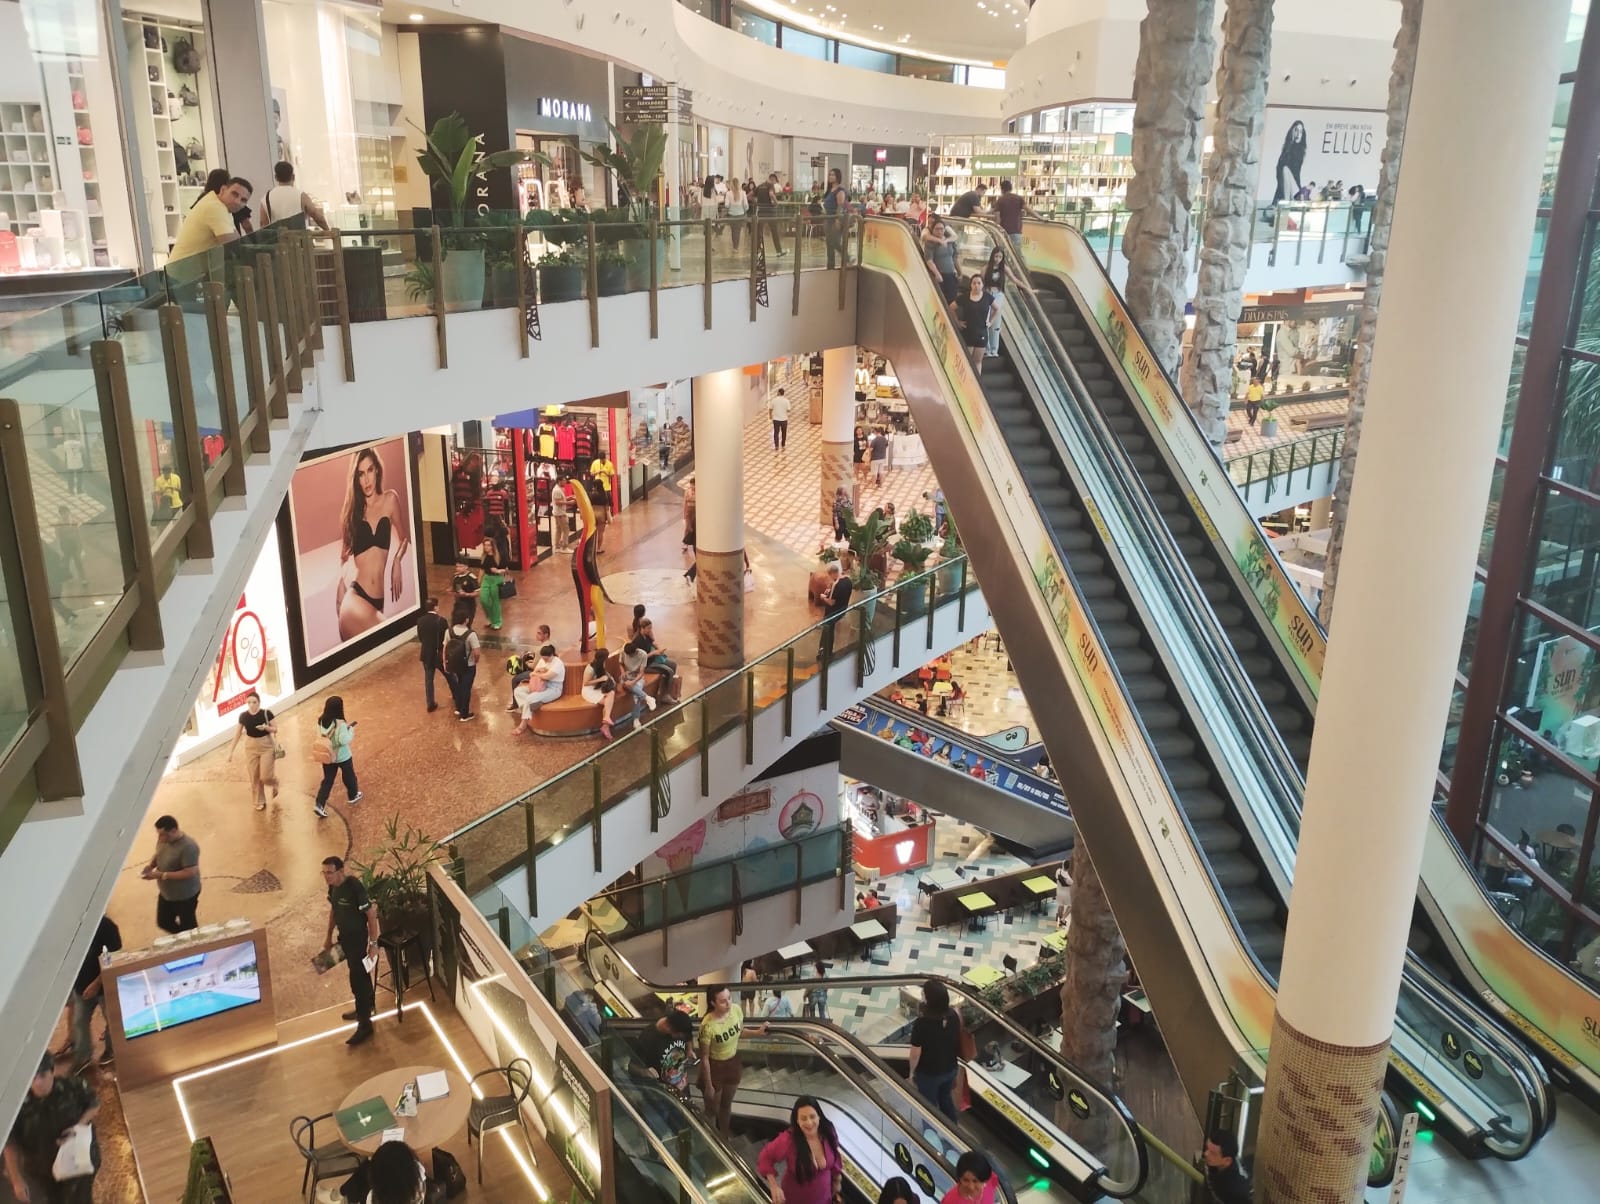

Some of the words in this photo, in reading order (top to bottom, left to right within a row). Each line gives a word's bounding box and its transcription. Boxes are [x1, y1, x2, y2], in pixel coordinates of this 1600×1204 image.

[542, 97, 592, 122] MORANA
[1321, 131, 1373, 154] ELLUS
[472, 132, 490, 218] ORANA
[1134, 350, 1151, 379] sun
[1290, 615, 1314, 652] sun
[1079, 632, 1099, 672] sun
[1552, 668, 1577, 689] sun
[714, 1023, 741, 1044] ROCK
